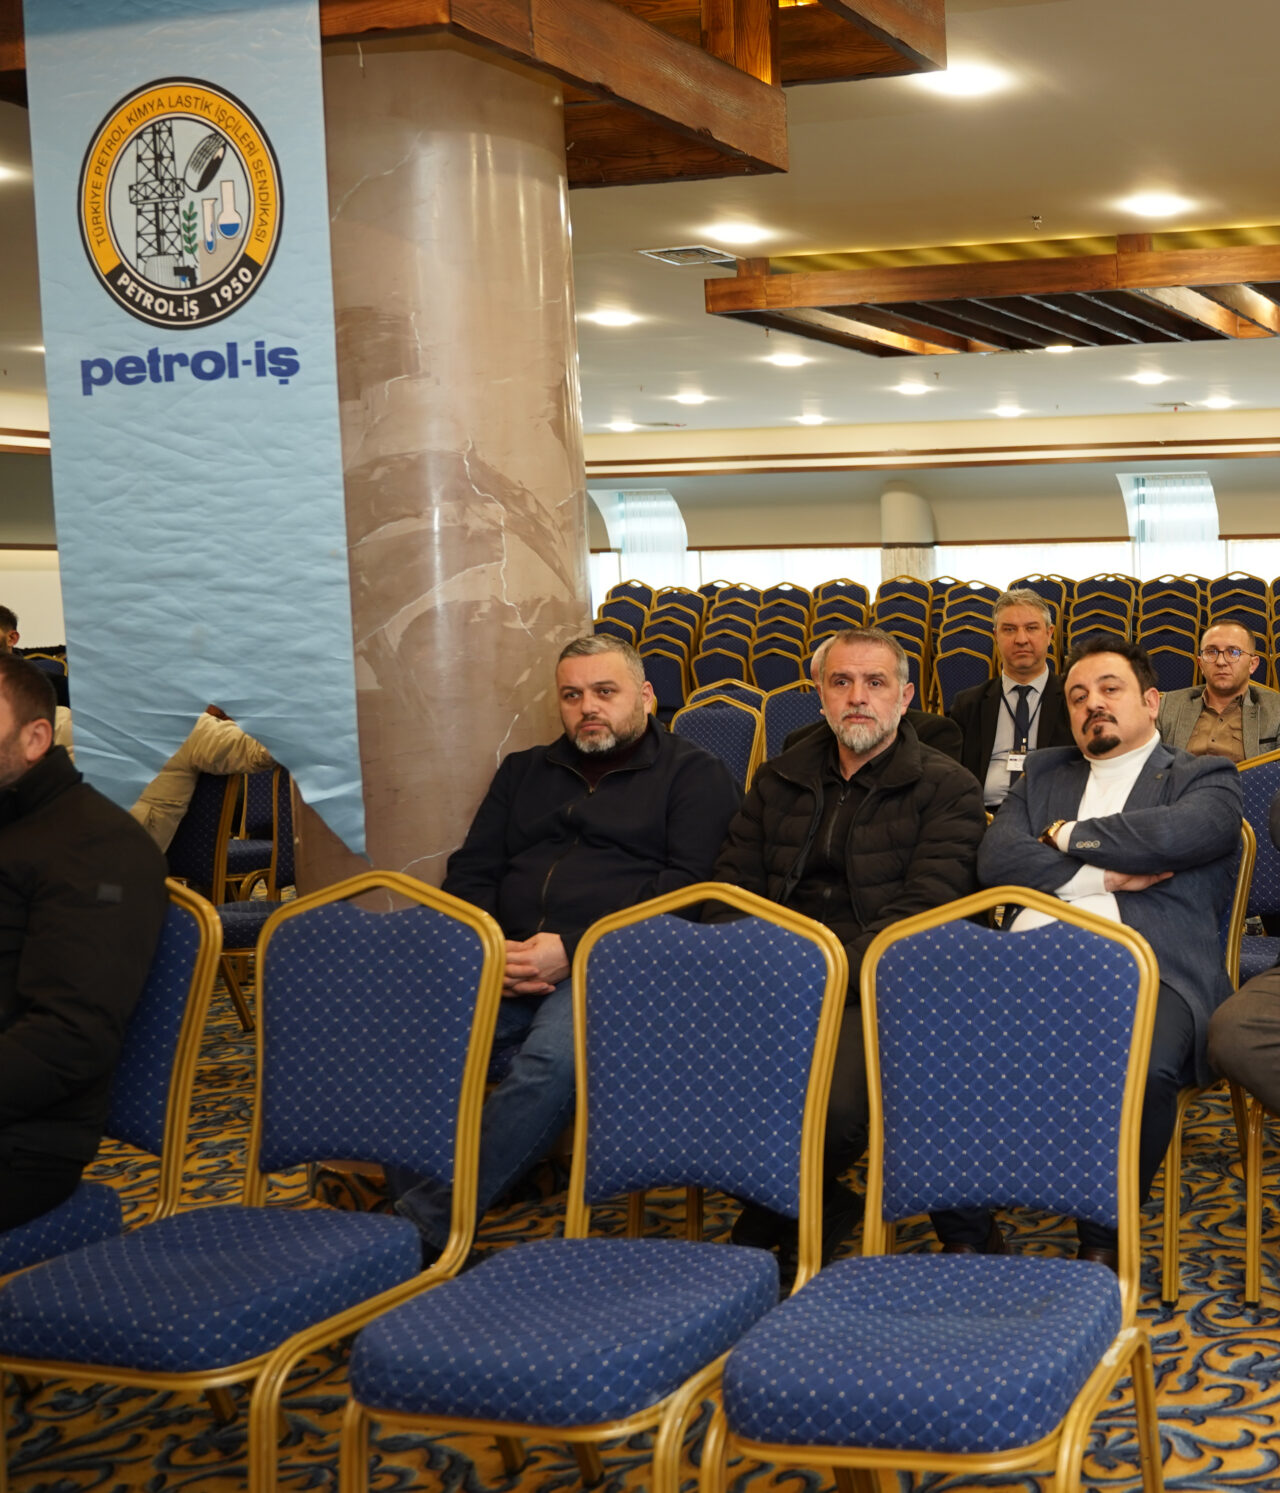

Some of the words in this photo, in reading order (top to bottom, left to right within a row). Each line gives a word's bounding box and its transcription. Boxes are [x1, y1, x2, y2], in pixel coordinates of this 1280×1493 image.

[126, 96, 165, 126] KİMYA
[168, 95, 212, 115] LASTİK
[214, 105, 260, 158] İŞÇİLERİ
[94, 126, 127, 178] PETROL
[91, 178, 107, 246] TÜRKİYE
[252, 158, 273, 243] SENDİKASI
[117, 274, 200, 320] PETROL-İŞ
[210, 266, 253, 309] 1950
[80, 340, 301, 397] petrol-iş
